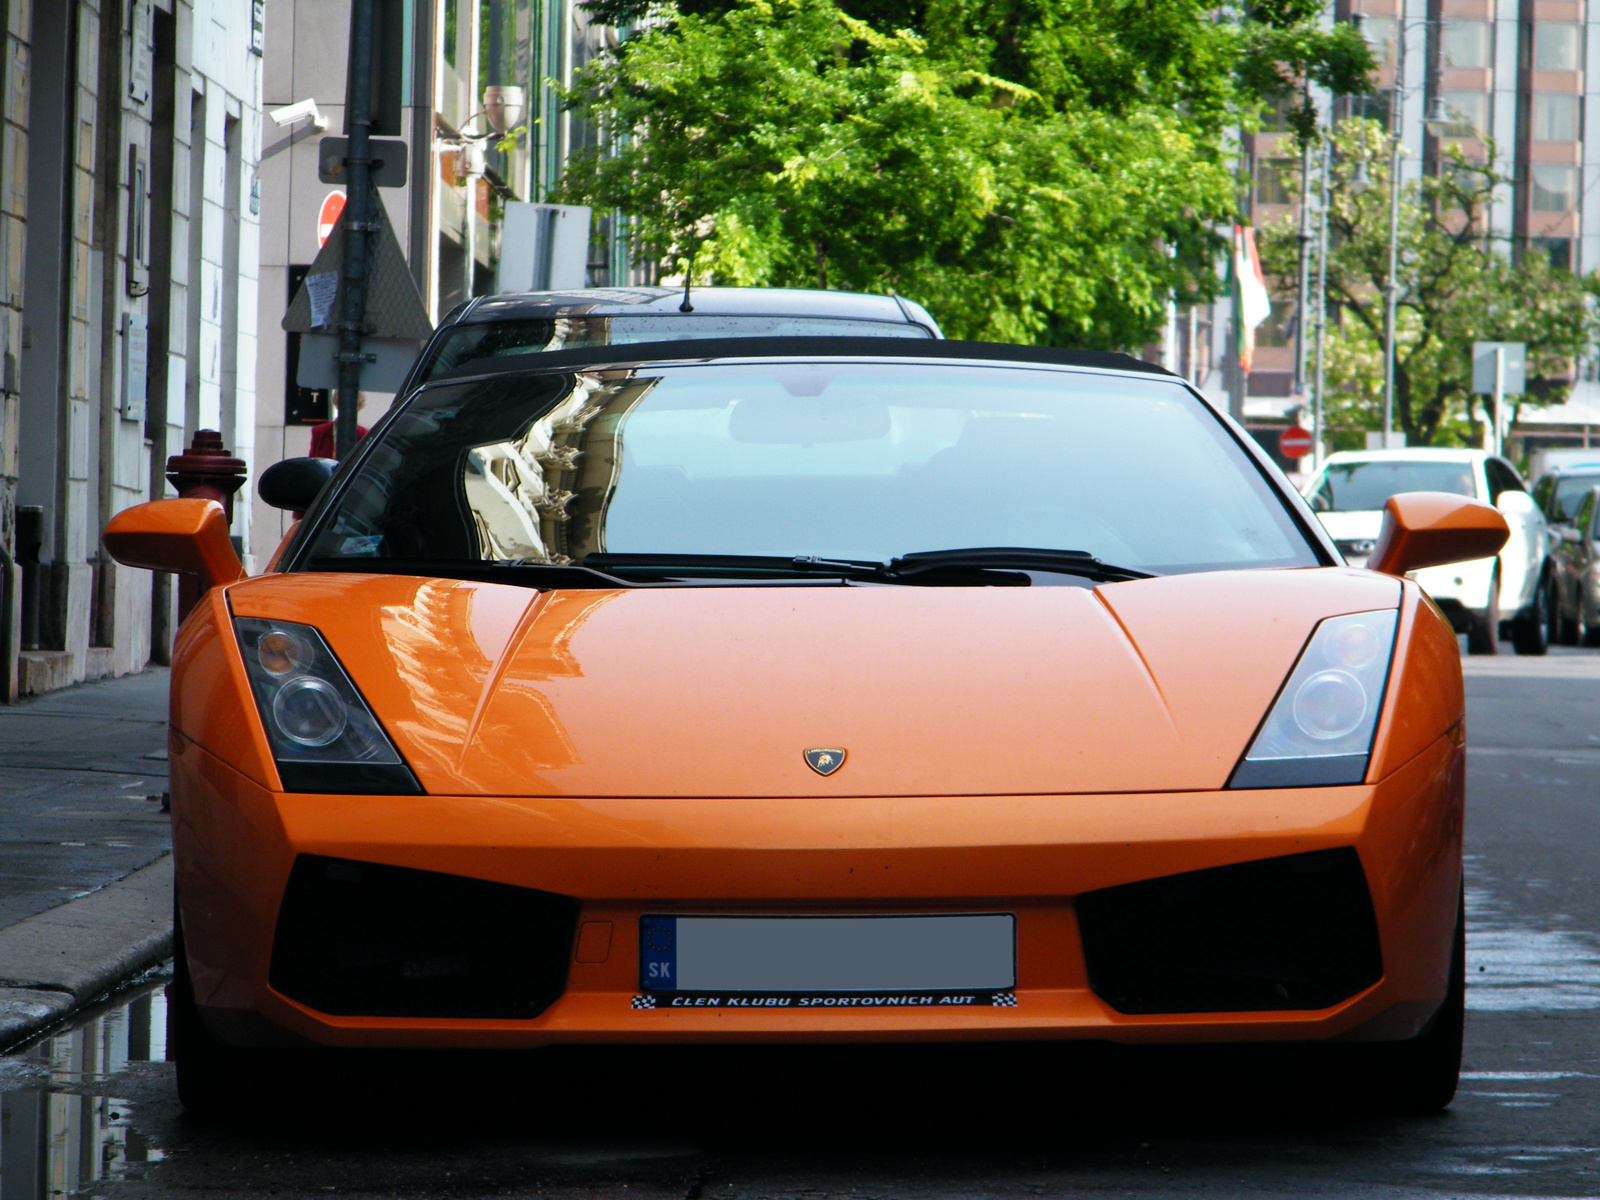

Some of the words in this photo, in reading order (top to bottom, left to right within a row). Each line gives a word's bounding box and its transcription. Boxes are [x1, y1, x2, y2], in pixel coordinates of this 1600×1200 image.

[649, 962, 670, 978] SK
[727, 997, 791, 1006] KLUBU
[939, 996, 976, 1005] AUT
